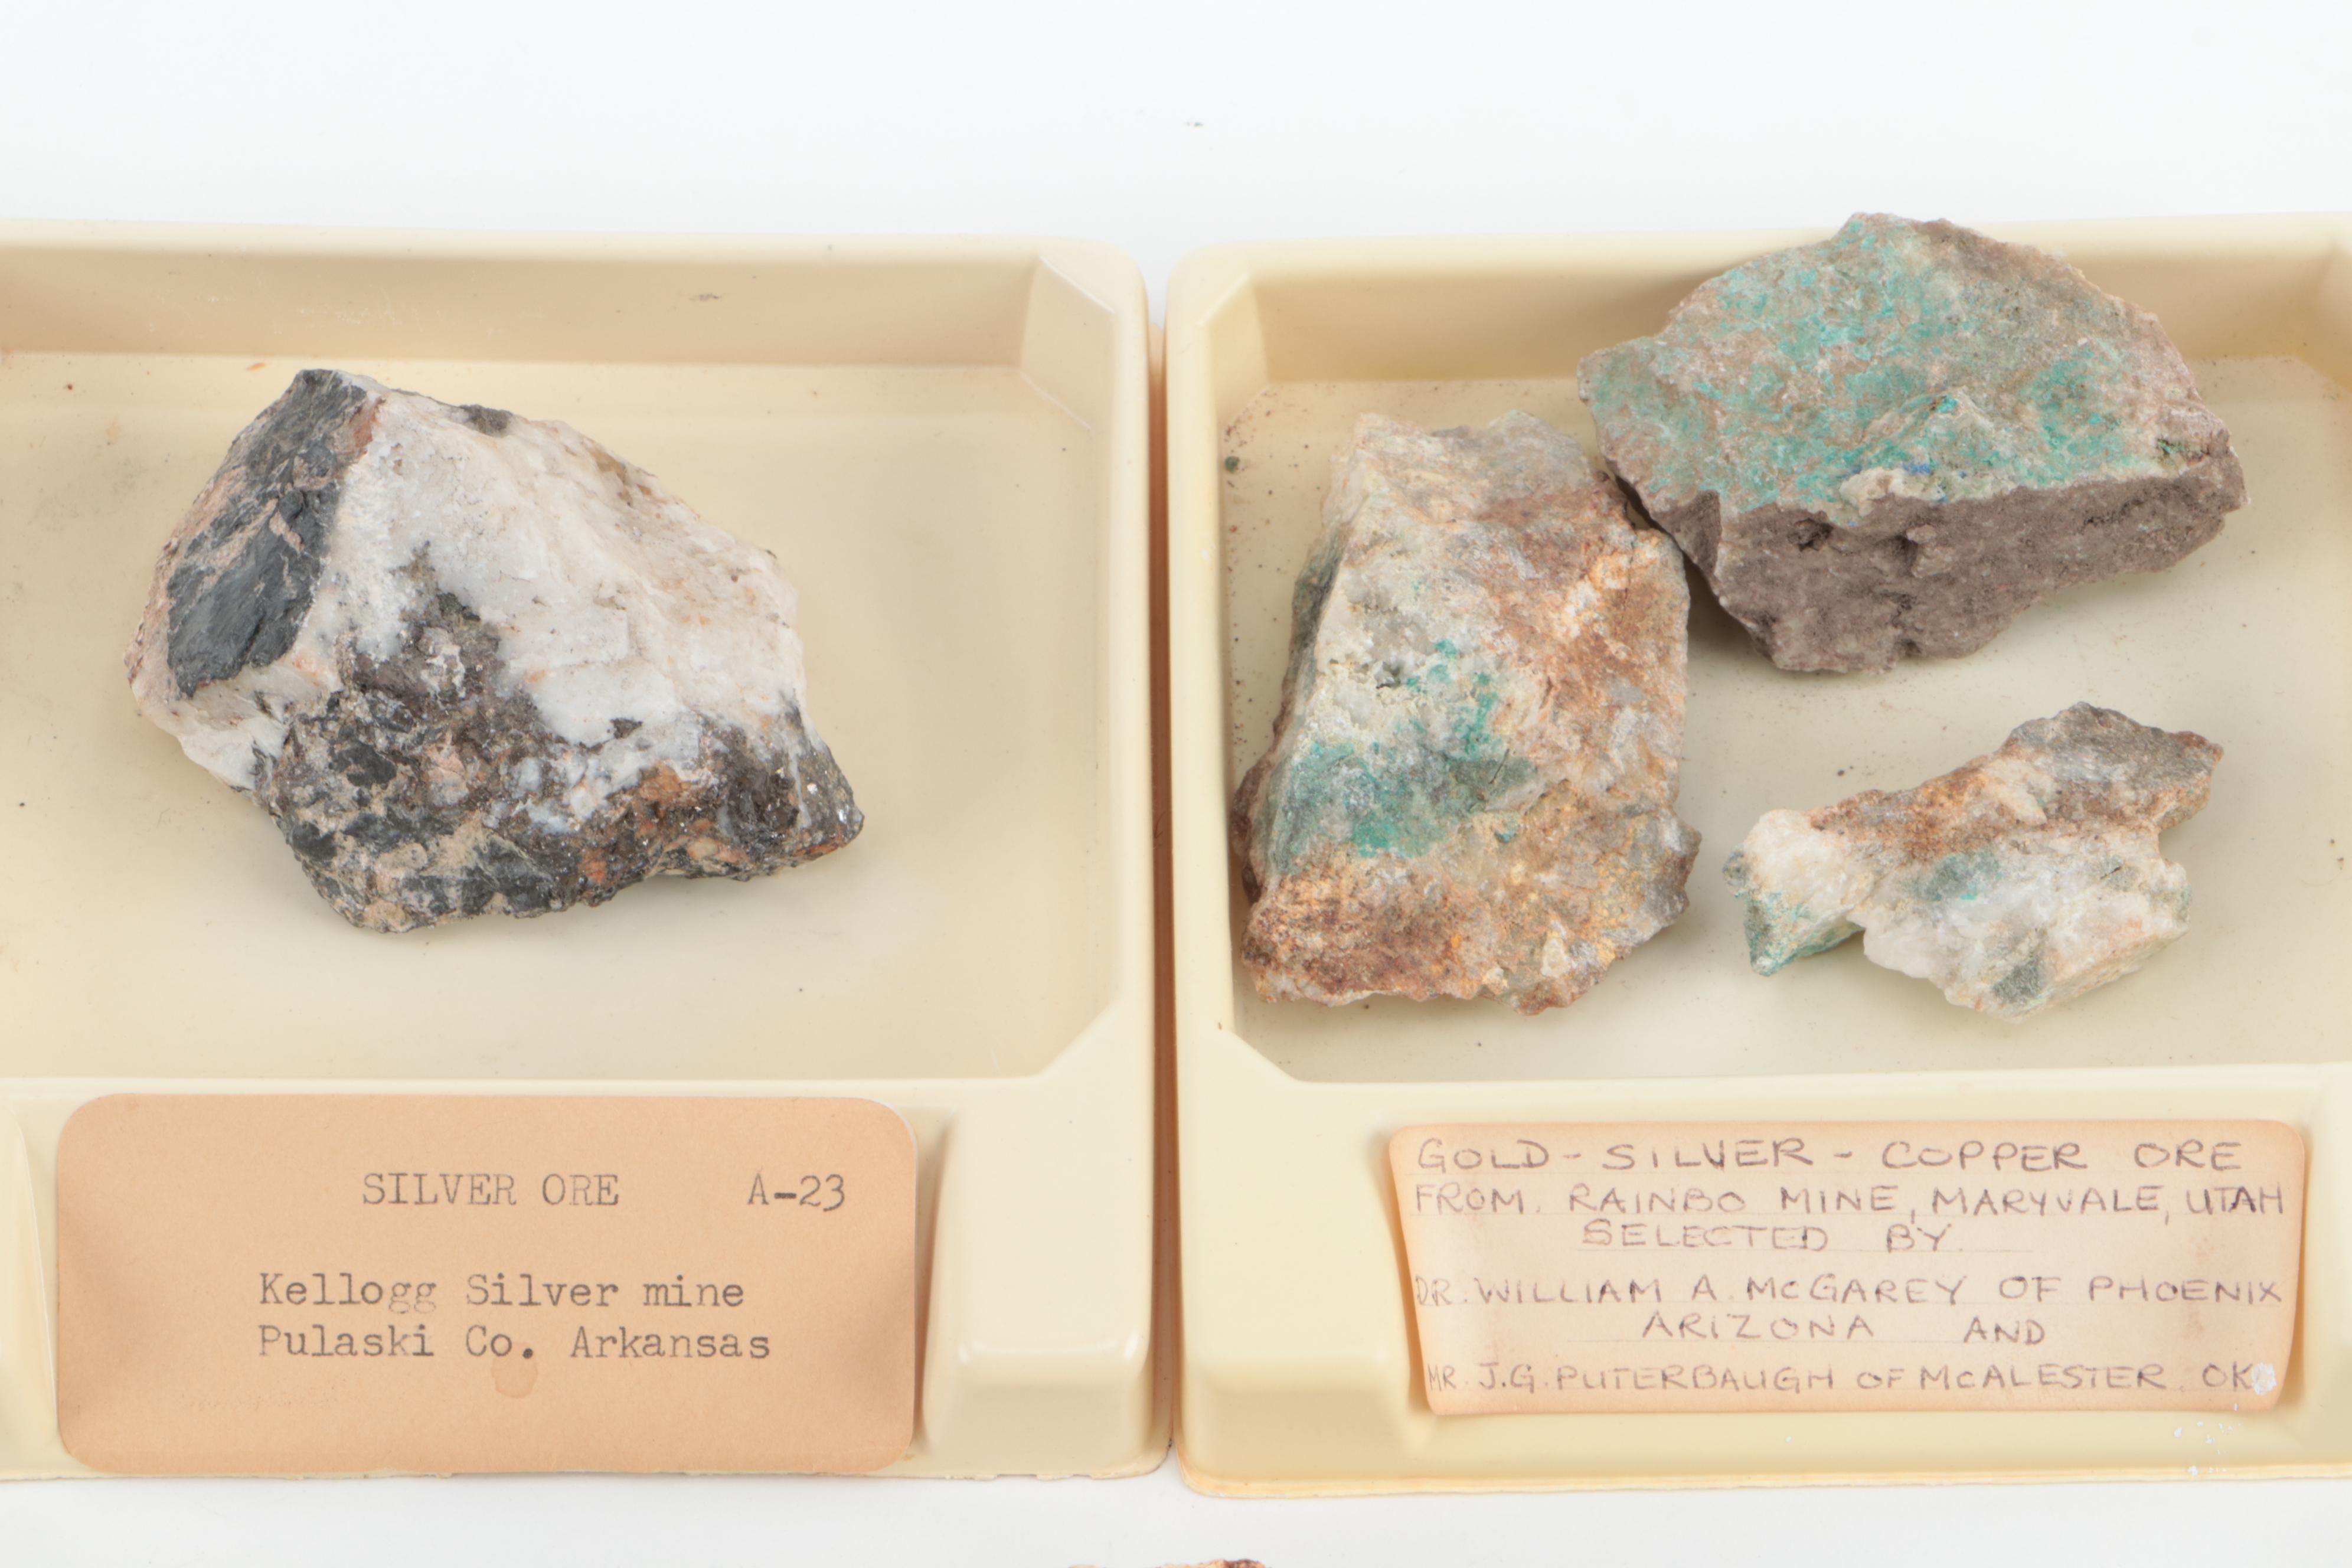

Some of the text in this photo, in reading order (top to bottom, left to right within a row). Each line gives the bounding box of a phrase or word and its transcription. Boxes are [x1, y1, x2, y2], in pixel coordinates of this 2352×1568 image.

[1417, 1137, 1550, 1174] GOLD
[1602, 1136, 1814, 1172] SILVER
[1881, 1139, 2088, 1172] COPPER
[2134, 1139, 2242, 1172] ORE
[362, 1172, 620, 1206] SILVER ORE
[746, 1170, 846, 1213] A-23
[1569, 1182, 1746, 1214] RAINBO
[1780, 1184, 1916, 1224] MINE,
[1931, 1184, 2170, 1226] MARYVALE,
[2185, 1185, 2284, 1216] UTAH
[1582, 1217, 1829, 1252] SELECTED
[259, 1272, 744, 1314] Kellogg Silver mine
[1415, 1273, 1468, 1306] DR.
[1474, 1275, 1662, 1305] WILLIAM
[1999, 1275, 2062, 1302] OF
[2088, 1275, 2284, 1305] PHOENIX
[258, 1324, 770, 1360] Pulaski Co. Arkansas
[1642, 1309, 2046, 1345] ARIZONA AND
[1556, 1363, 1834, 1394] PUTERBAUGH
[1856, 1367, 1906, 1390] OF
